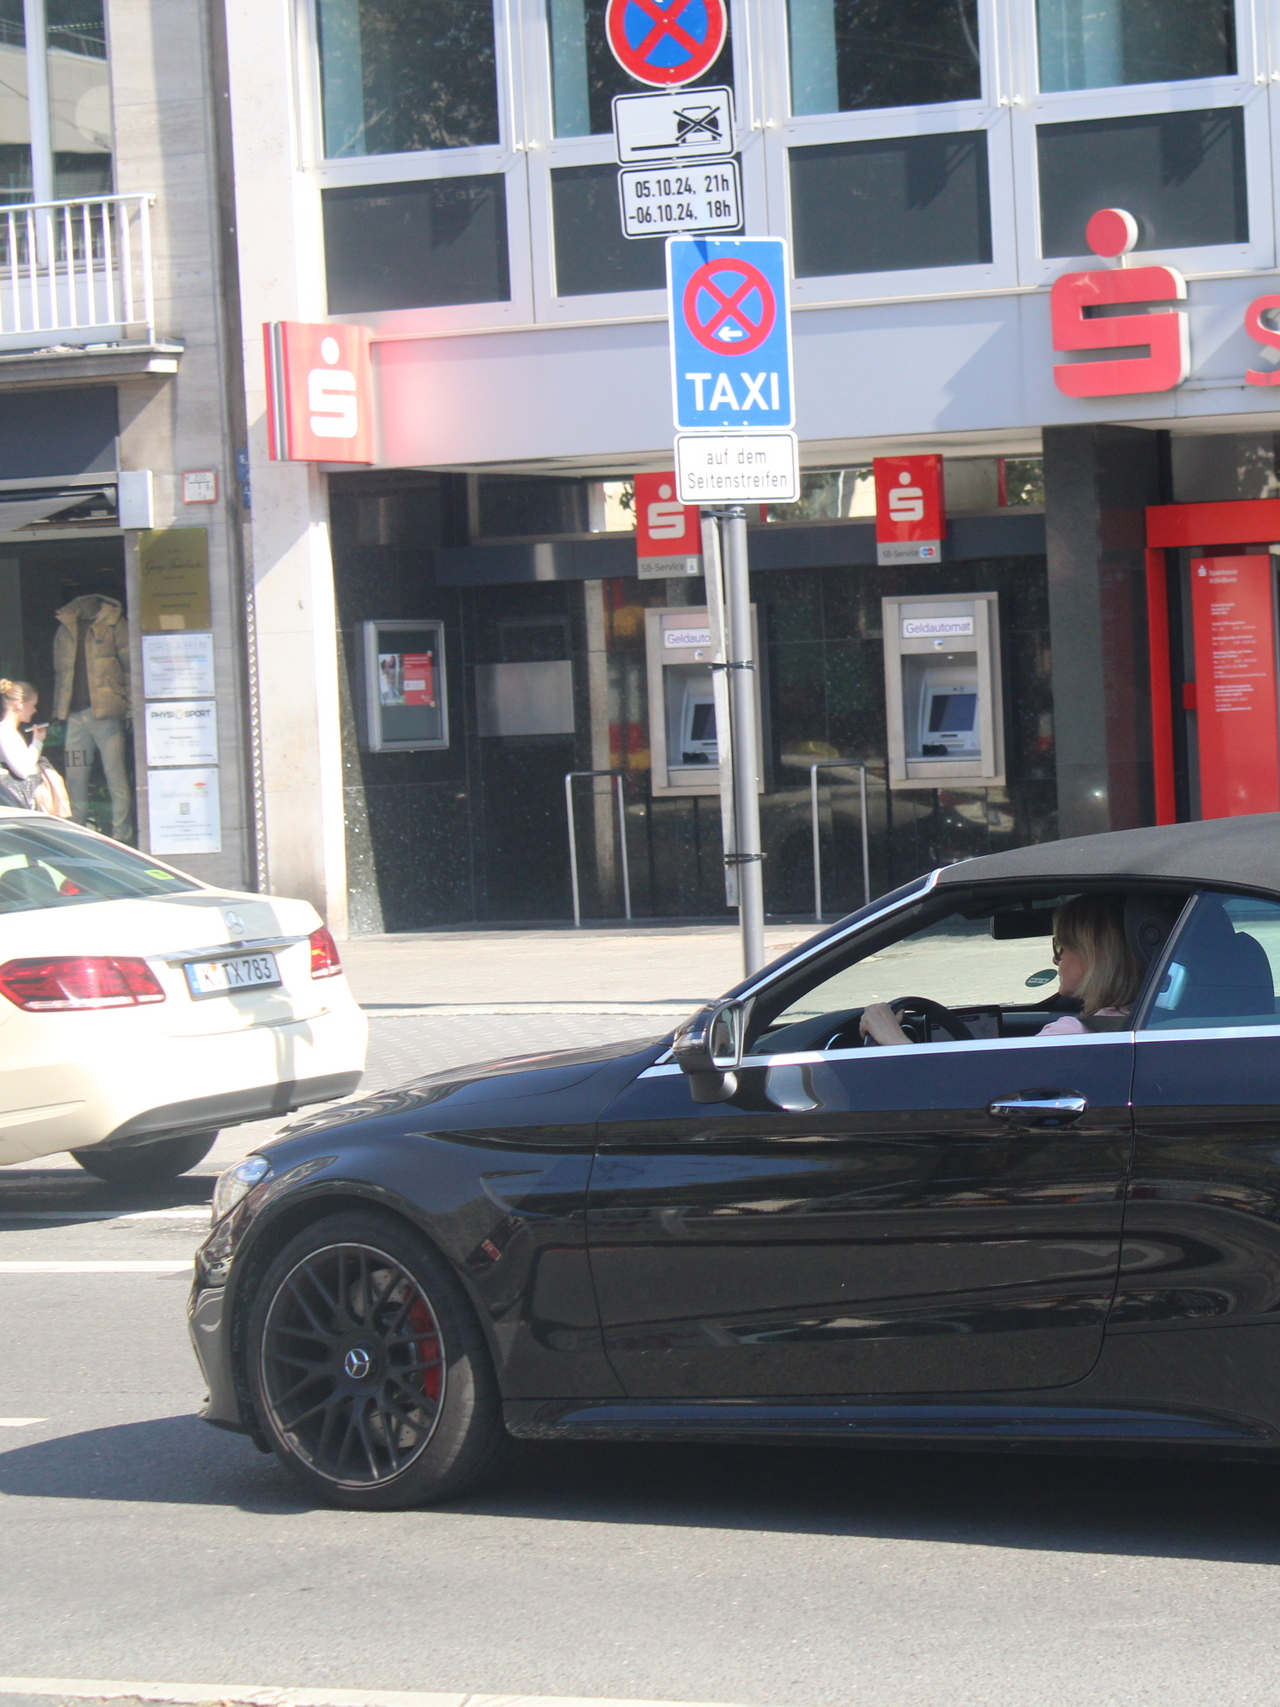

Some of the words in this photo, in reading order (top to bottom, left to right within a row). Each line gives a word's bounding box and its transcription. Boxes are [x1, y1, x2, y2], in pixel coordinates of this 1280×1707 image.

[704, 174, 729, 193] 21h
[707, 200, 731, 219] 18h
[684, 372, 780, 411] TAXI
[706, 447, 729, 466] auf
[737, 447, 767, 465] dem
[687, 472, 788, 490] Seitenstreifen
[641, 562, 686, 573] SB-Service
[905, 622, 971, 634] Geldautomat
[201, 966, 215, 987] K
[222, 961, 245, 985] TX
[242, 957, 272, 982] 783
